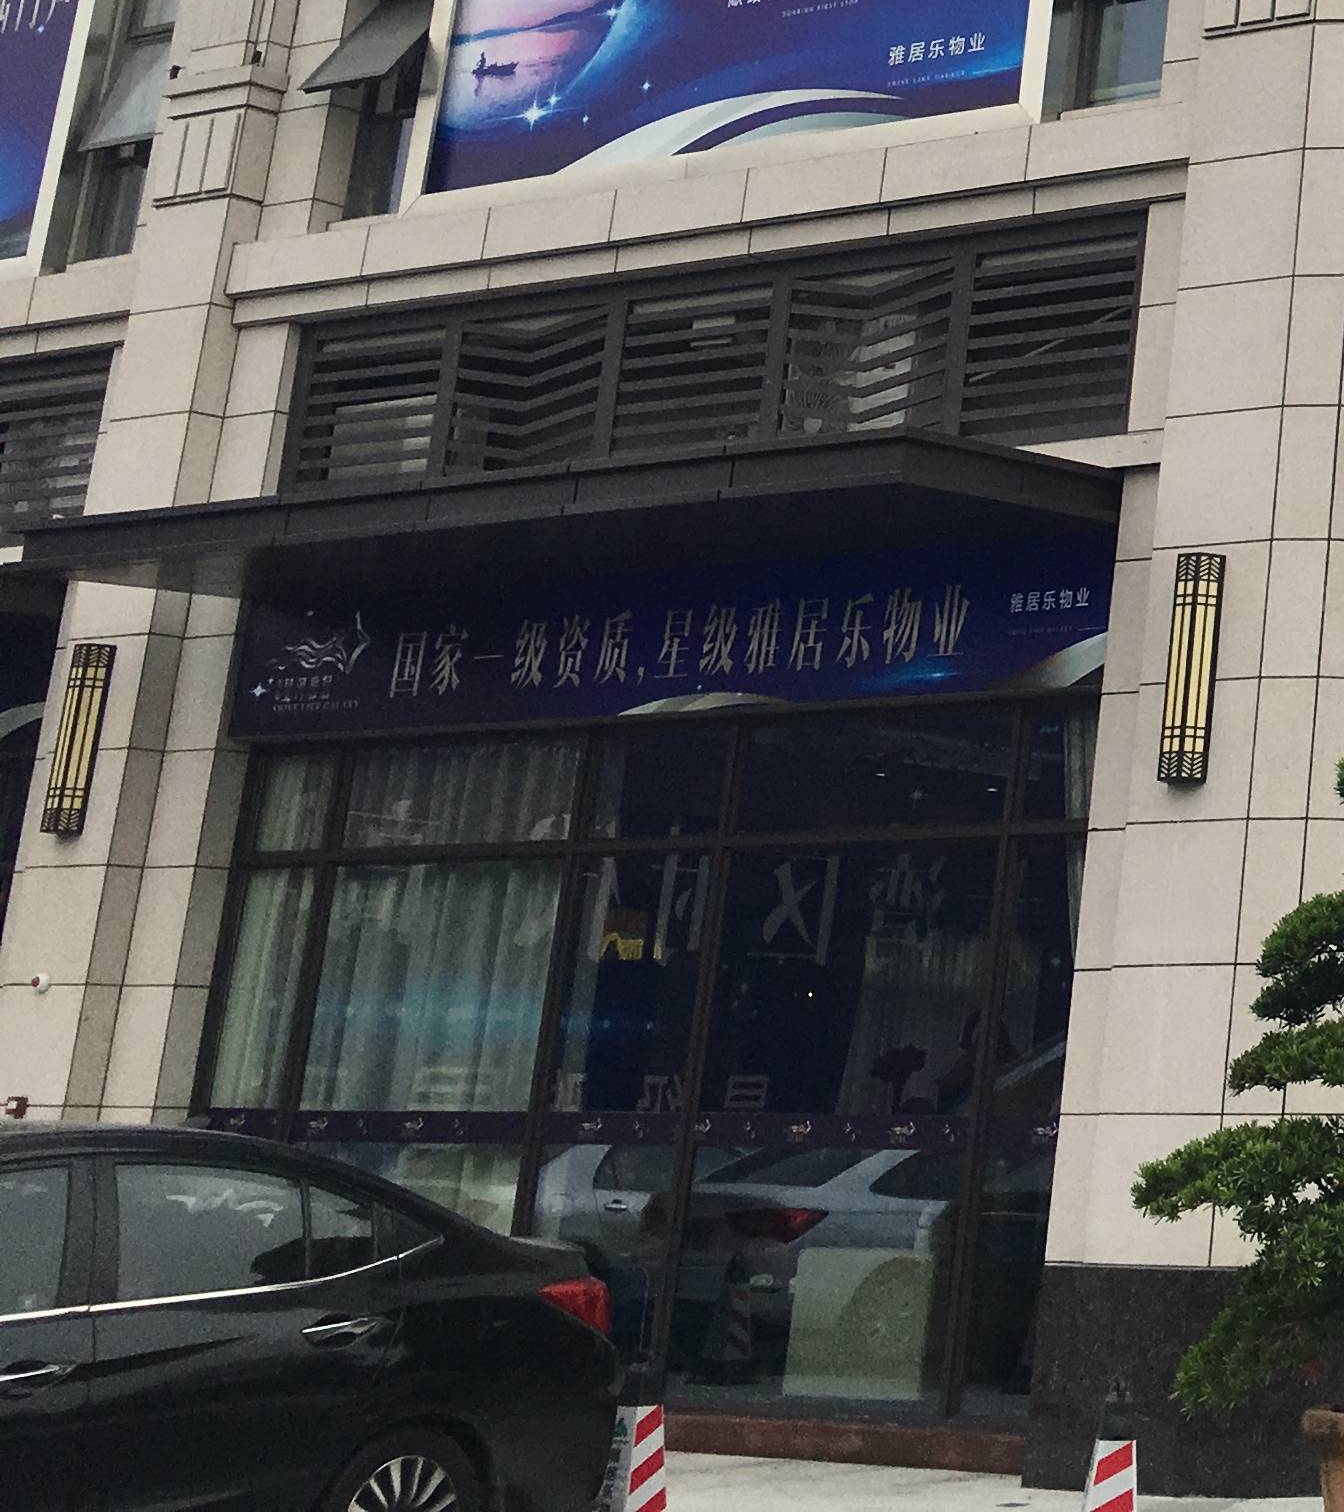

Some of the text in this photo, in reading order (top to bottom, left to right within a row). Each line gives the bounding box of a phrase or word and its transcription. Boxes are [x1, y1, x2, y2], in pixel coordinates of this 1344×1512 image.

[887, 32, 986, 67] 雅居乐物业
[1009, 587, 1090, 613] 雅居乐物业
